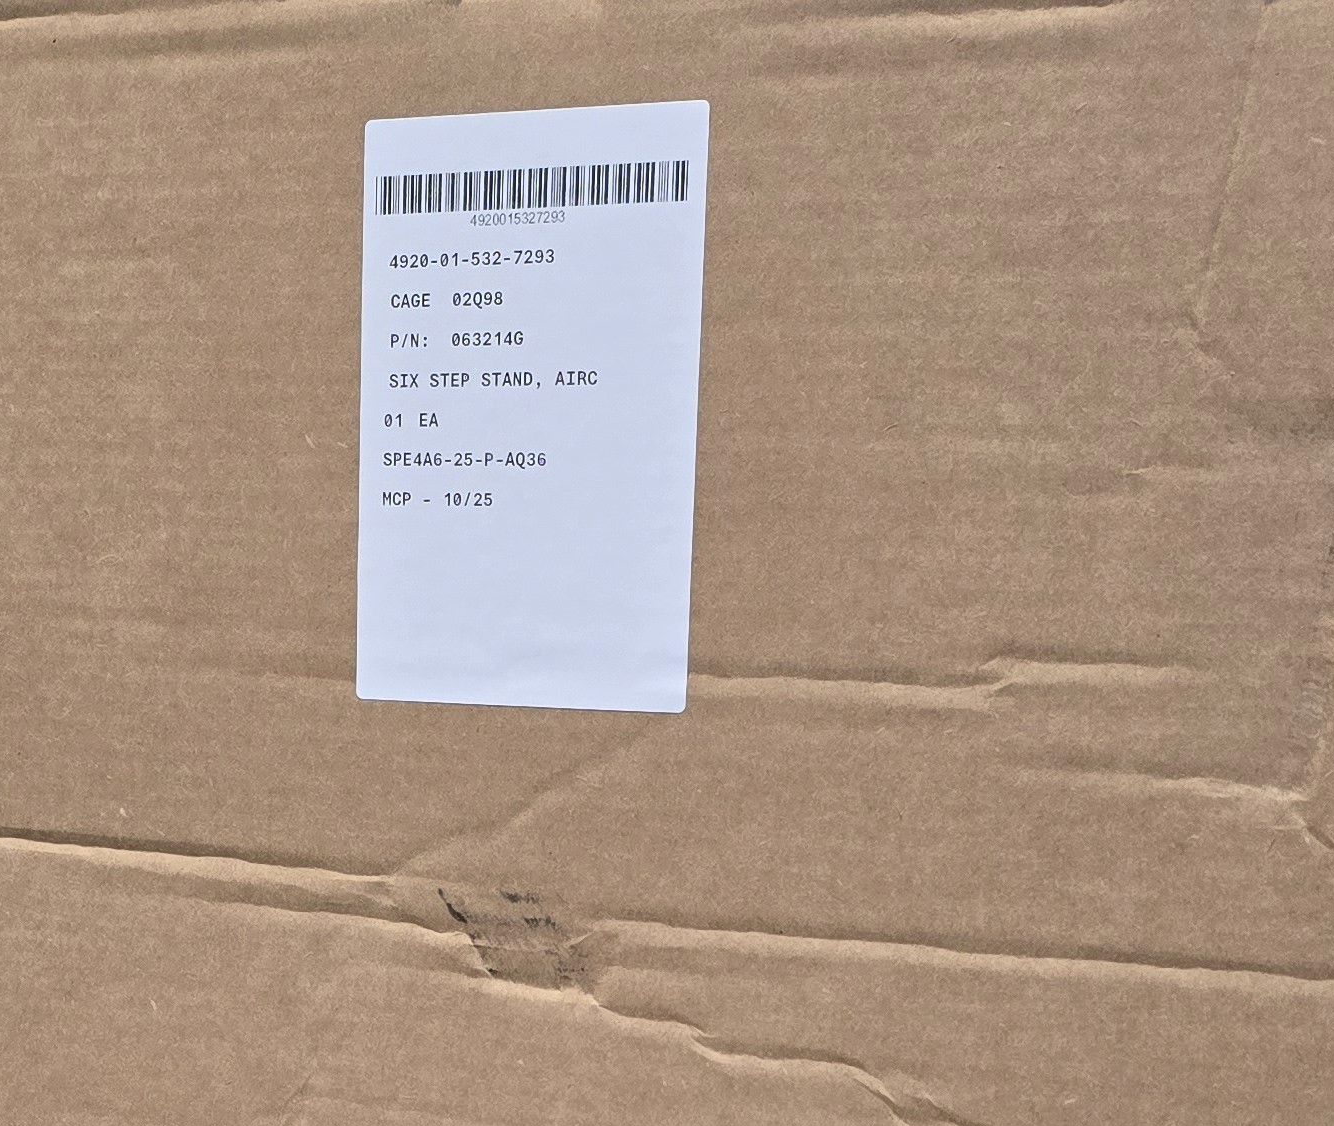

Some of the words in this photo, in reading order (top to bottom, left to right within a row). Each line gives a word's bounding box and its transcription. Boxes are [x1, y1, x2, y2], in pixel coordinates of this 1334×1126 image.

[470, 211, 565, 227] 4920015327293
[389, 249, 555, 269] 4920-01-532-7293
[391, 293, 430, 308] CAGE
[452, 292, 503, 307] 02Q98
[390, 333, 429, 348] P/N:
[451, 331, 524, 347] 063214G
[389, 374, 419, 388] SIX
[430, 373, 469, 387] STEP
[481, 371, 542, 389] STAND,
[555, 371, 598, 385] AIRC
[384, 414, 403, 428] 01
[419, 413, 438, 427] EA
[383, 452, 547, 469] SPE4A6-25-P-AQ36
[382, 492, 411, 506] MCP
[444, 492, 493, 507] 10/25
